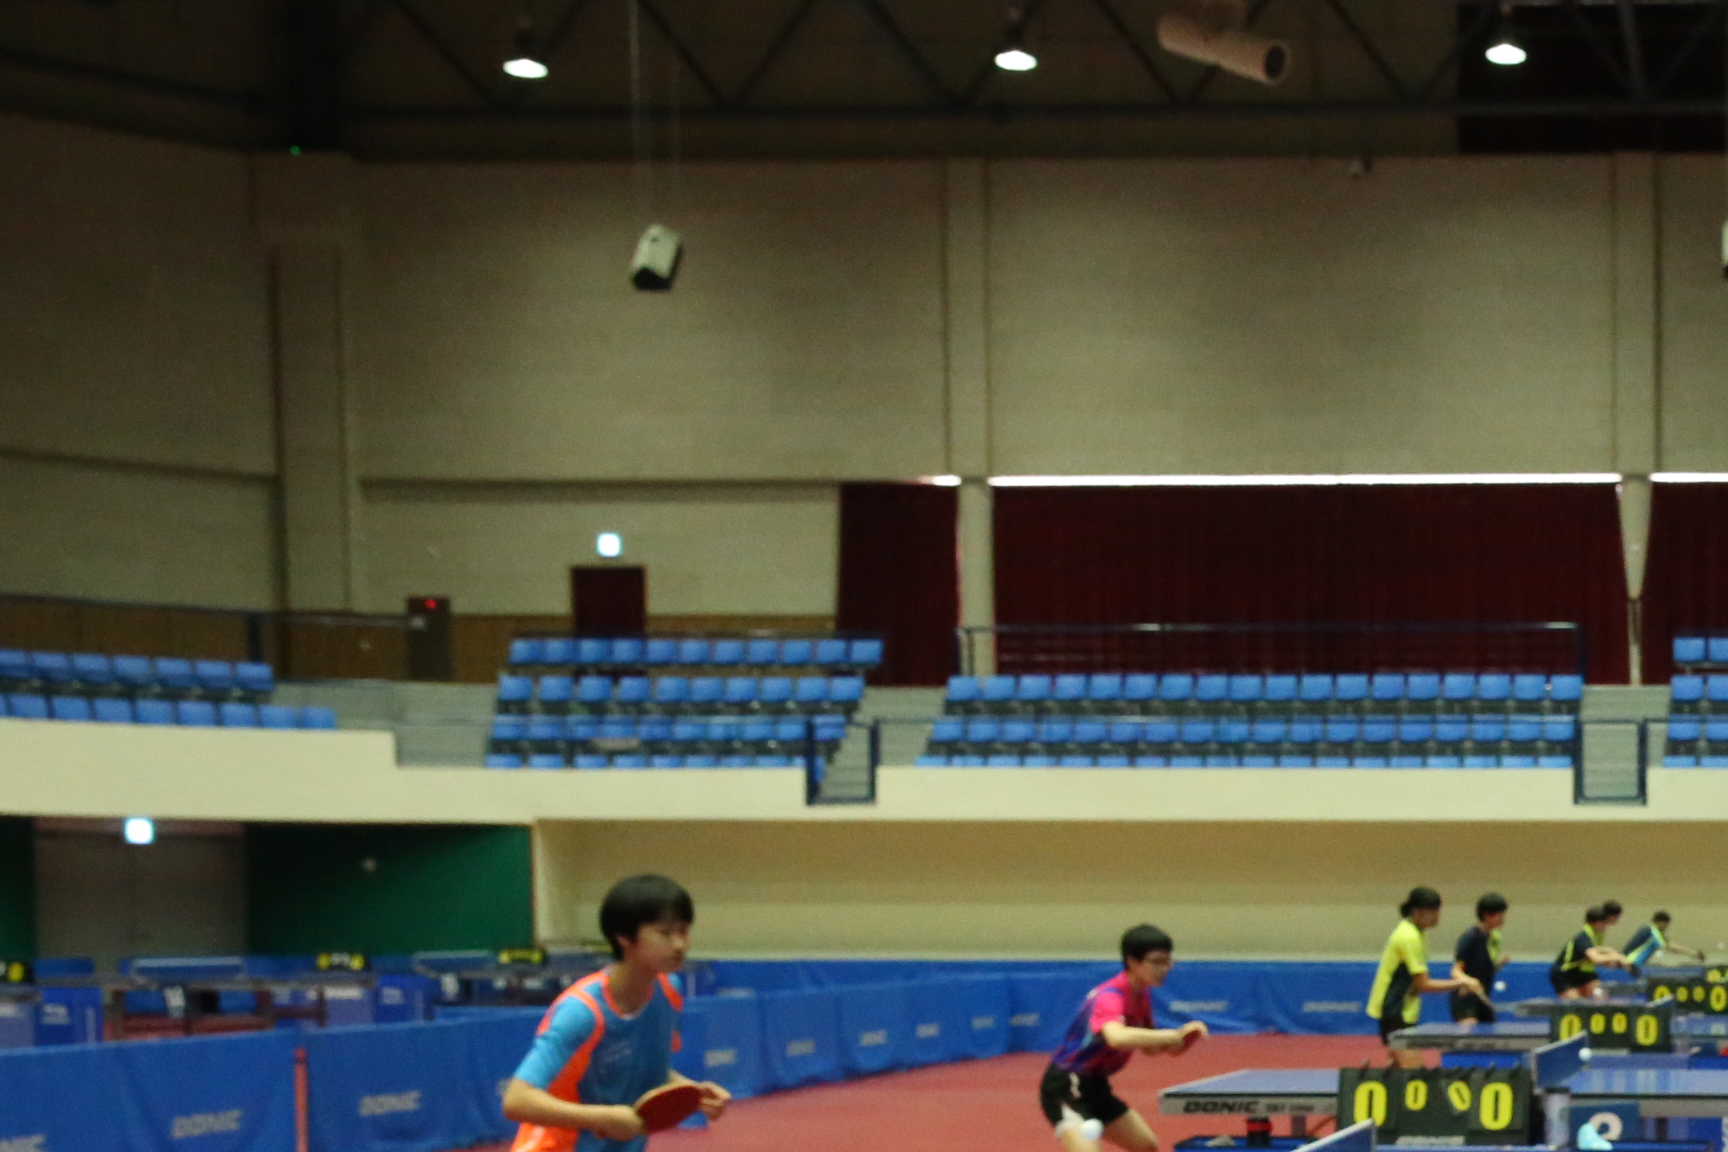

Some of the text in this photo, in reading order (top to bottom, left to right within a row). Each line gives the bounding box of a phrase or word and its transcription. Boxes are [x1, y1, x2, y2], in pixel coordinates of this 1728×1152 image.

[1353, 1079, 1513, 1130] 0 0 0 0
